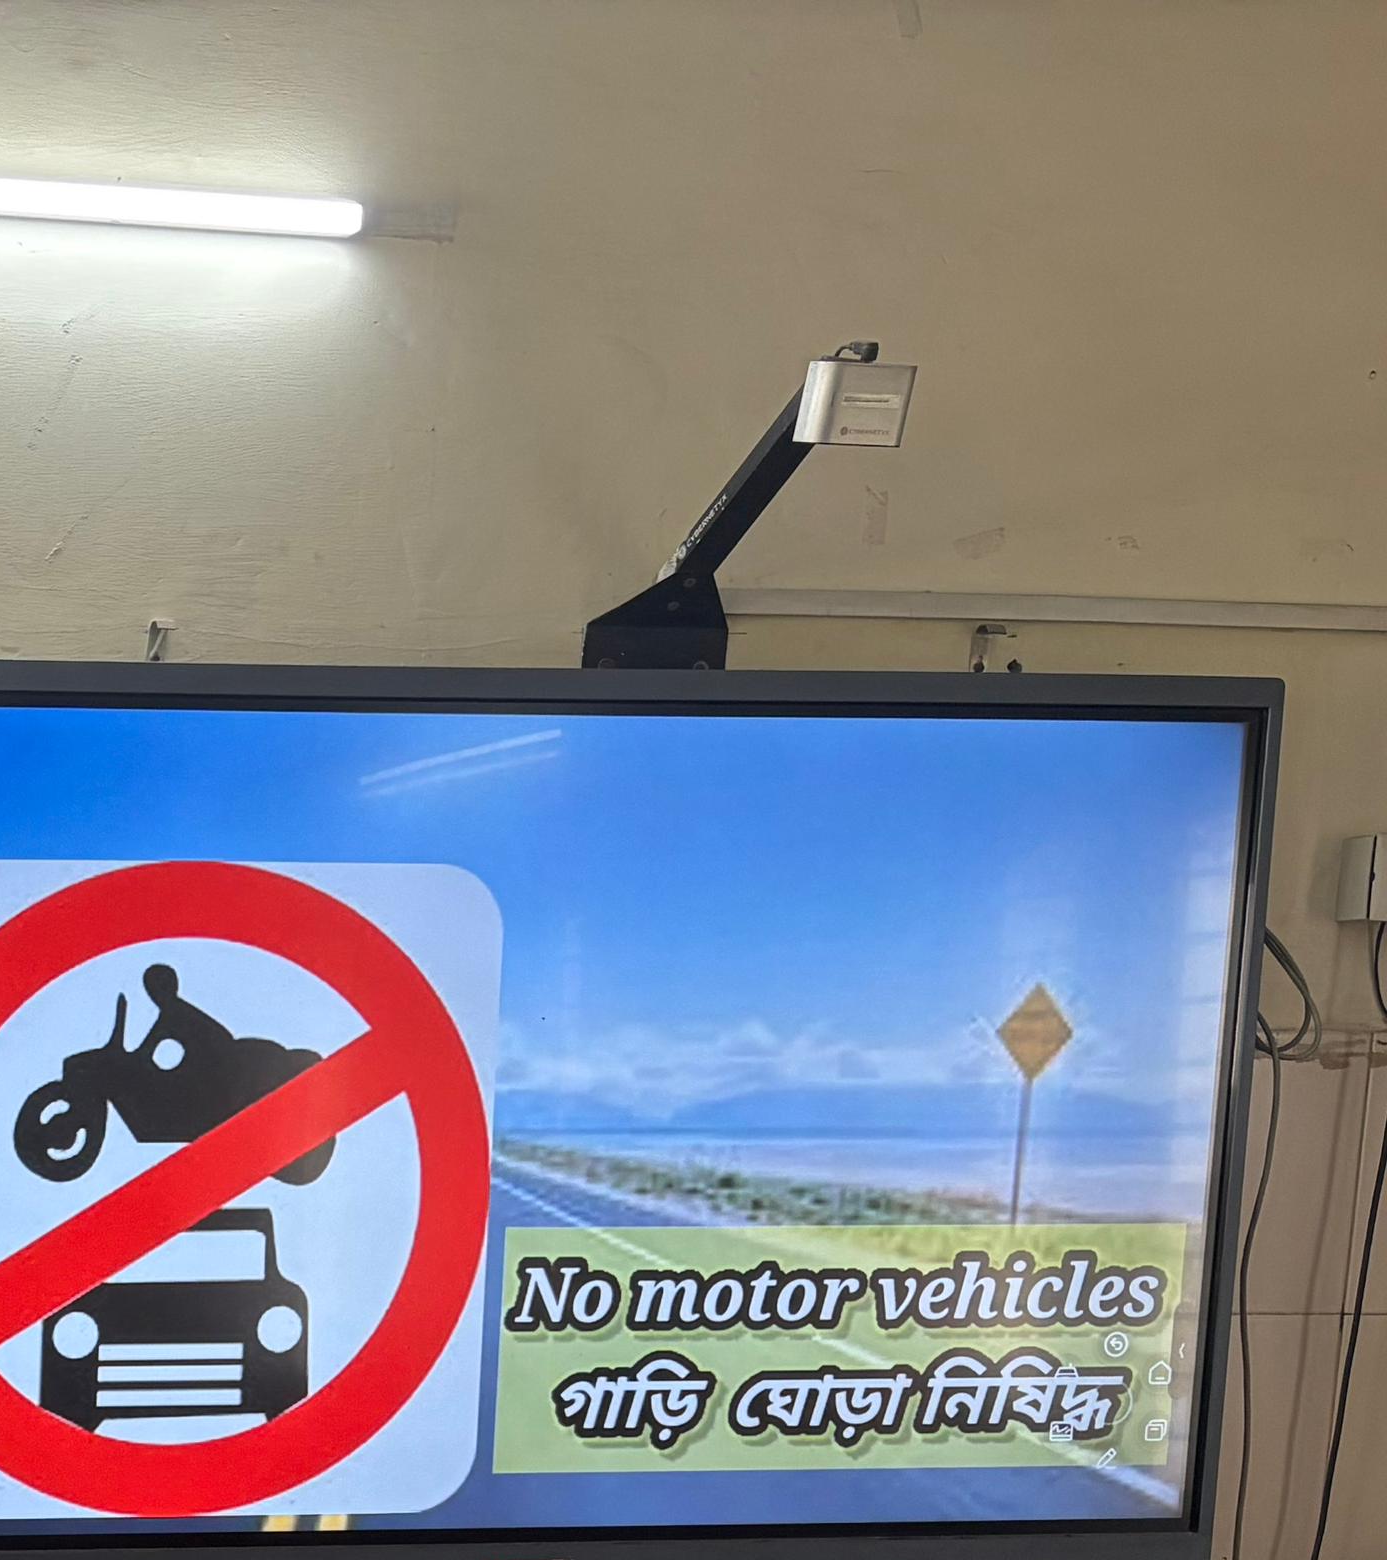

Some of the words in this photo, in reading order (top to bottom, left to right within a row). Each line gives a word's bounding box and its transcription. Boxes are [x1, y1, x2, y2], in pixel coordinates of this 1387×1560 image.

[511, 1262, 617, 1328] No
[629, 1262, 861, 1327] motor
[878, 1256, 1162, 1325] vehicles
[558, 1354, 713, 1443] গাড়ি
[734, 1367, 912, 1443] ঘোড়া
[921, 1351, 1132, 1432] নিষিদ্ধ
